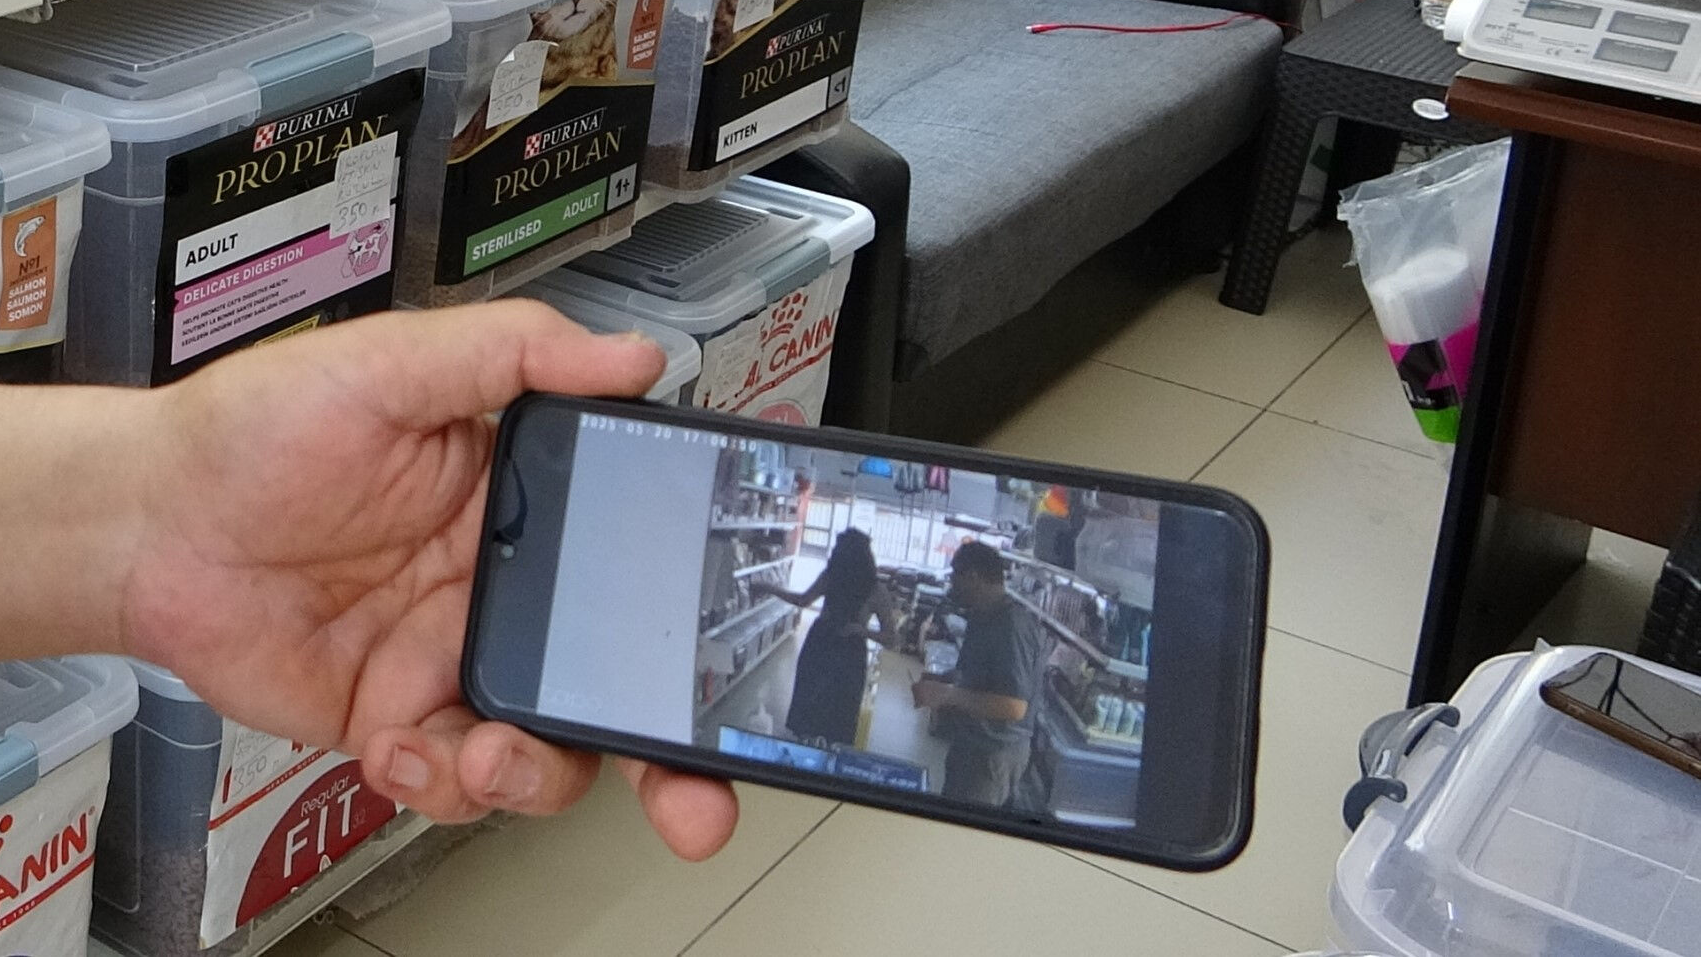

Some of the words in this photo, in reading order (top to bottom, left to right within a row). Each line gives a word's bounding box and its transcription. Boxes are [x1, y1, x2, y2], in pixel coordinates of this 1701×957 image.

[778, 16, 824, 50] PURINA
[740, 57, 784, 100] PRO
[786, 30, 846, 79] PLAN
[275, 99, 350, 141] PURINA
[542, 113, 600, 150] PURINA
[722, 122, 759, 149] KITTEN
[212, 150, 288, 206] PRO
[292, 114, 389, 174] PLAN
[491, 158, 550, 207] PRO
[554, 126, 627, 179] PLAN
[471, 218, 542, 262] STERILISED
[562, 192, 601, 221] ADULT
[614, 178, 631, 199] 1+
[185, 233, 239, 268] ADULT
[8, 276, 47, 299] SALMON
[183, 273, 240, 304] DELICATE
[243, 246, 305, 280] DIGESTION
[6, 288, 47, 311] SAUMON
[8, 301, 44, 322] SOMON
[300, 775, 351, 818] Regular
[283, 783, 361, 879] FIT
